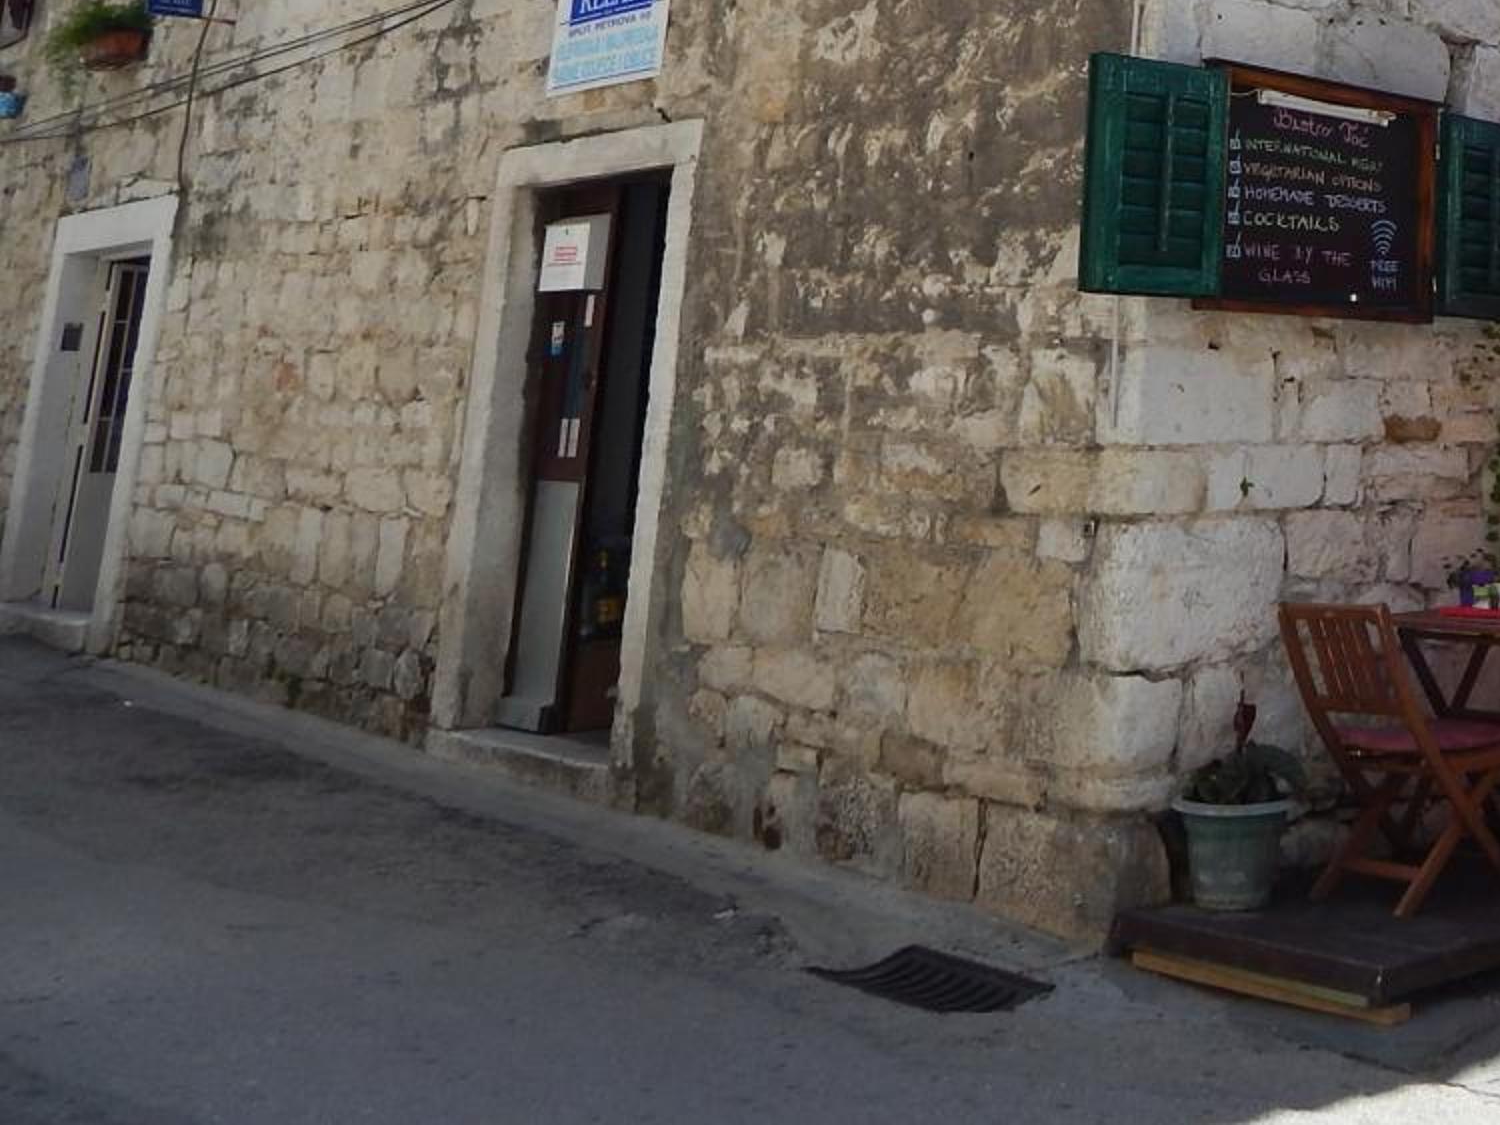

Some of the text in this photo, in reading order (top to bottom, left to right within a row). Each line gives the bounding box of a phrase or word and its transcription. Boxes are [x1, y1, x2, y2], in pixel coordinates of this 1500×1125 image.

[1245, 138, 1346, 164] INTERNATIONAL
[1244, 161, 1325, 185] VEGETARIAN
[1244, 186, 1388, 214] HOMEMADE DESSERTS
[1243, 210, 1341, 232] COCKTAILS
[1243, 241, 1281, 261] WINE
[1320, 250, 1352, 267] THE
[1258, 268, 1312, 285] GLASS
